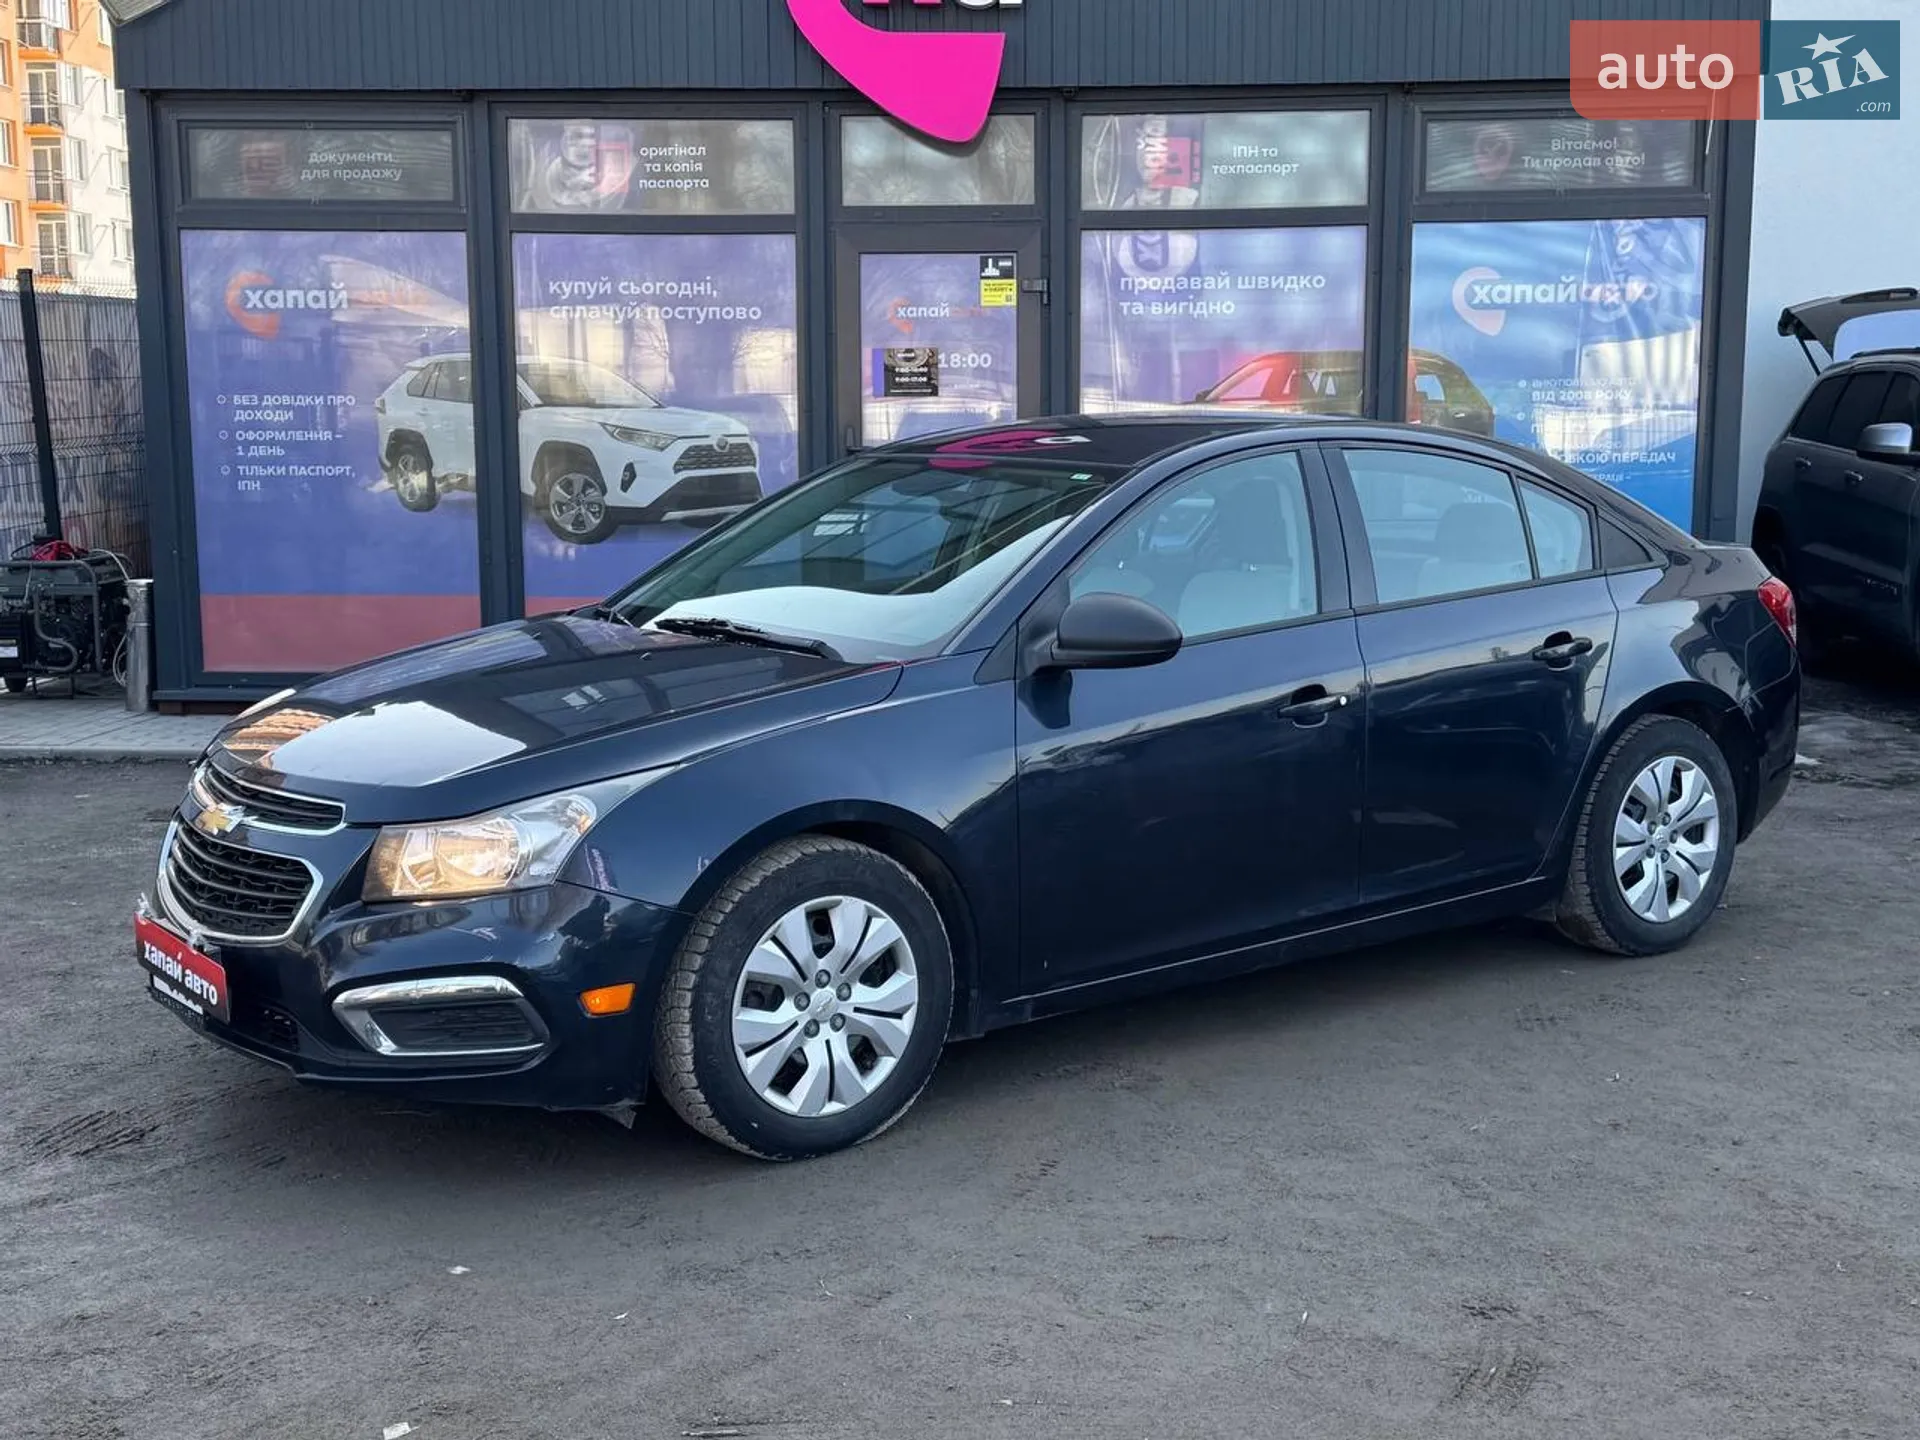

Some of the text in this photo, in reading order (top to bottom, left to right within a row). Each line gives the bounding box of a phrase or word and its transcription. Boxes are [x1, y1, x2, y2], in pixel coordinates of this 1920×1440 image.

[1551, 137, 1618, 151] Вітаємо!
[639, 144, 707, 160] оригінал
[1232, 145, 1278, 158] ІПН та
[308, 152, 393, 166] документи
[1522, 156, 1541, 168] Ти
[1544, 156, 1602, 169] продав
[645, 160, 703, 174] та копія
[1211, 161, 1300, 177] техпаспорт
[300, 168, 403, 182] для продажу
[639, 177, 710, 190] паспорта
[549, 276, 718, 299] купуй сьогодні,
[1120, 271, 1326, 294] продавай швидко
[549, 301, 762, 323] сплачуй поступово
[1120, 296, 1236, 318] та вигідно
[232, 395, 356, 407] БЕЗ ДОВІДКИ ПРО
[1531, 391, 1556, 402] ВІД
[234, 410, 294, 421] ДОХОДИ
[235, 430, 333, 441] ОФОРМЛЕННЯ
[236, 446, 285, 457] 1 ДЕНЬ
[1612, 451, 1676, 465] ПЕРЕДАЧ
[237, 465, 287, 477] ТІЛЬКИ
[237, 480, 261, 491] ІПН
[184, 968, 218, 1006] авто
